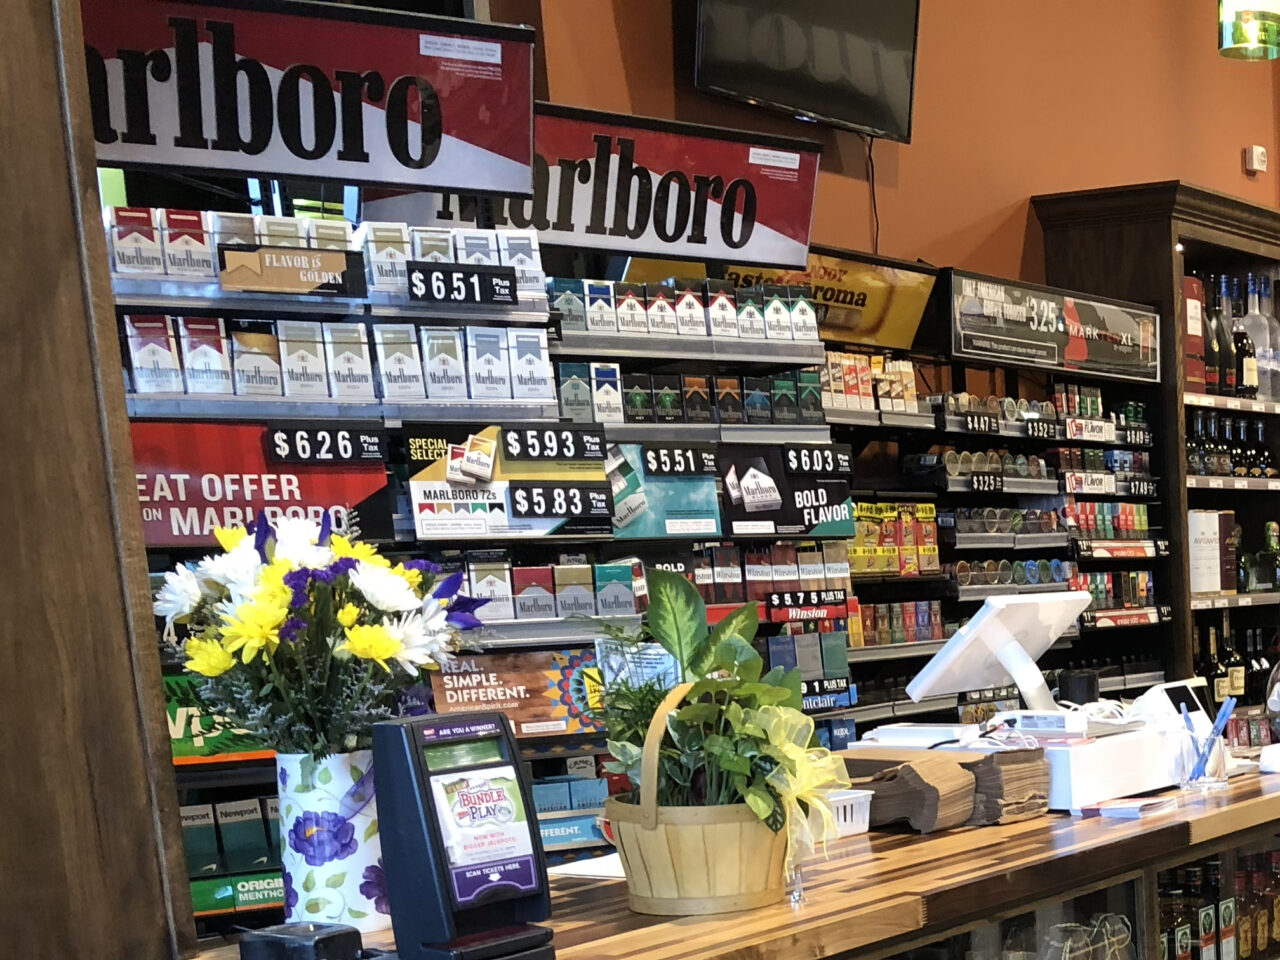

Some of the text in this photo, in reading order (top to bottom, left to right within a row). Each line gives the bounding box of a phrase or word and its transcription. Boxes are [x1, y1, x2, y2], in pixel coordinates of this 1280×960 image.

[437, 134, 757, 250] arlboro
[117, 247, 162, 266] Marlboro
[168, 250, 211, 268] Marlboro
[264, 254, 309, 269] FLAVOR
[300, 270, 343, 285] GOLDEN
[492, 277, 511, 288] Plus
[494, 286, 510, 296] Tax
[287, 364, 323, 382] Marlboro
[334, 368, 369, 384] Marlboro
[385, 368, 420, 384] Marlboro
[429, 369, 463, 385] Marlboro
[475, 370, 506, 386] Marlboro
[517, 371, 548, 386] Marlboro
[360, 434, 379, 444] Plus
[409, 438, 448, 451] SPECIAL
[583, 435, 600, 444] Plus
[364, 443, 379, 452] Tax
[585, 442, 600, 451] Tax
[702, 452, 715, 460] Plus
[704, 458, 715, 466] Tax
[838, 453, 849, 461] Plus
[202, 474, 302, 501] OFFER
[743, 481, 777, 498] Marlboro
[423, 489, 478, 501] MARLBORO
[589, 492, 606, 501] Plus
[795, 489, 827, 509] BOLD
[591, 500, 607, 508] Tax
[143, 509, 162, 521] ON
[803, 505, 849, 526] FLAVOR
[716, 570, 741, 582] Winston
[600, 594, 632, 609] Marlboro
[821, 591, 834, 600] PLUS
[835, 590, 845, 600] TAX
[520, 599, 553, 612] Marlboro
[560, 596, 593, 611] Marlboro
[788, 606, 828, 620] Winston
[441, 659, 484, 673] REAL.
[443, 672, 503, 688] SIMPLE.
[446, 686, 530, 704] DIFFERENT.
[568, 760, 594, 770] CAMEL
[460, 788, 505, 807] BUNDLE
[220, 807, 259, 819] Newport
[470, 804, 498, 820] PLAY
[466, 870, 482, 878] SCAN
[482, 866, 504, 875] TICKETS
